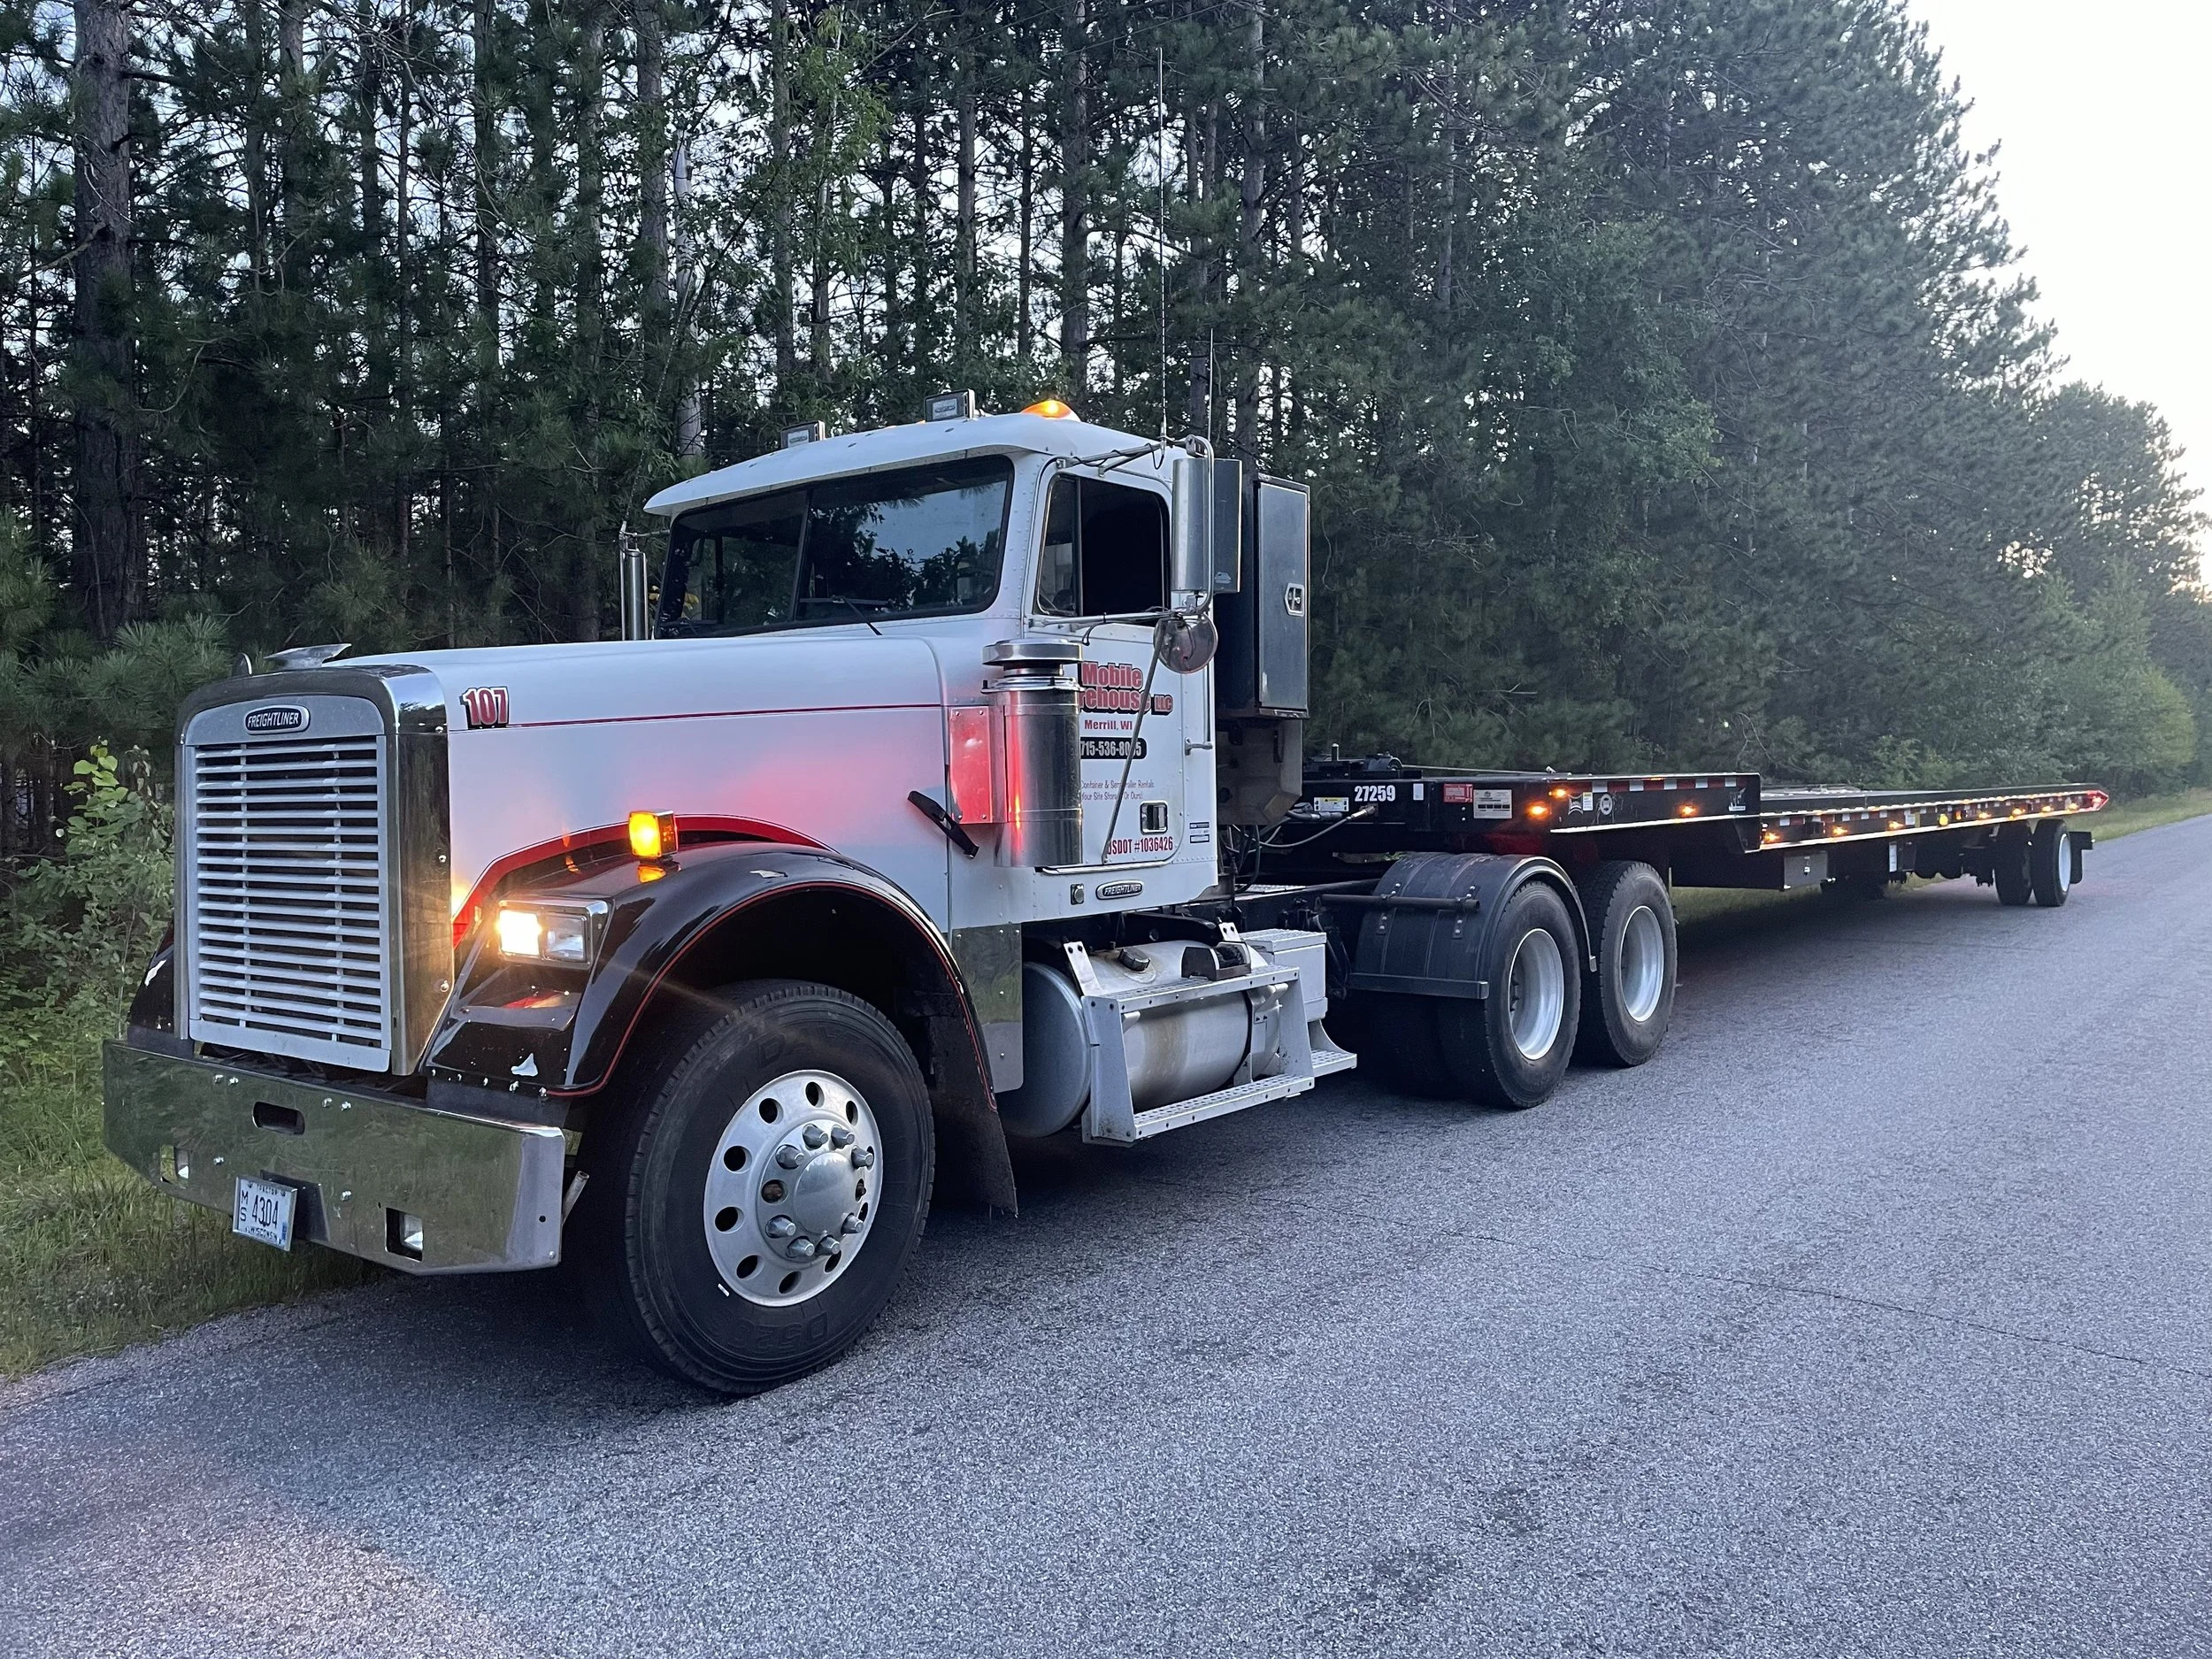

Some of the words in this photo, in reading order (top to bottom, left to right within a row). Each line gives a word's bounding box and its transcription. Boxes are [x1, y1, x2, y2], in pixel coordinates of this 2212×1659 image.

[1080, 661, 1143, 689] Mobile
[461, 687, 509, 727] 107
[248, 711, 299, 727] FREIGHTLINER
[1084, 719, 1119, 731] Merrill,
[1120, 720, 1133, 730] WI
[1080, 741, 1141, 757] 715-536-805
[1354, 785, 1396, 802] 27259
[1133, 835, 1173, 853] #1036426
[1104, 884, 1141, 895] FREIGHTLINER
[251, 1194, 279, 1230] 4304
